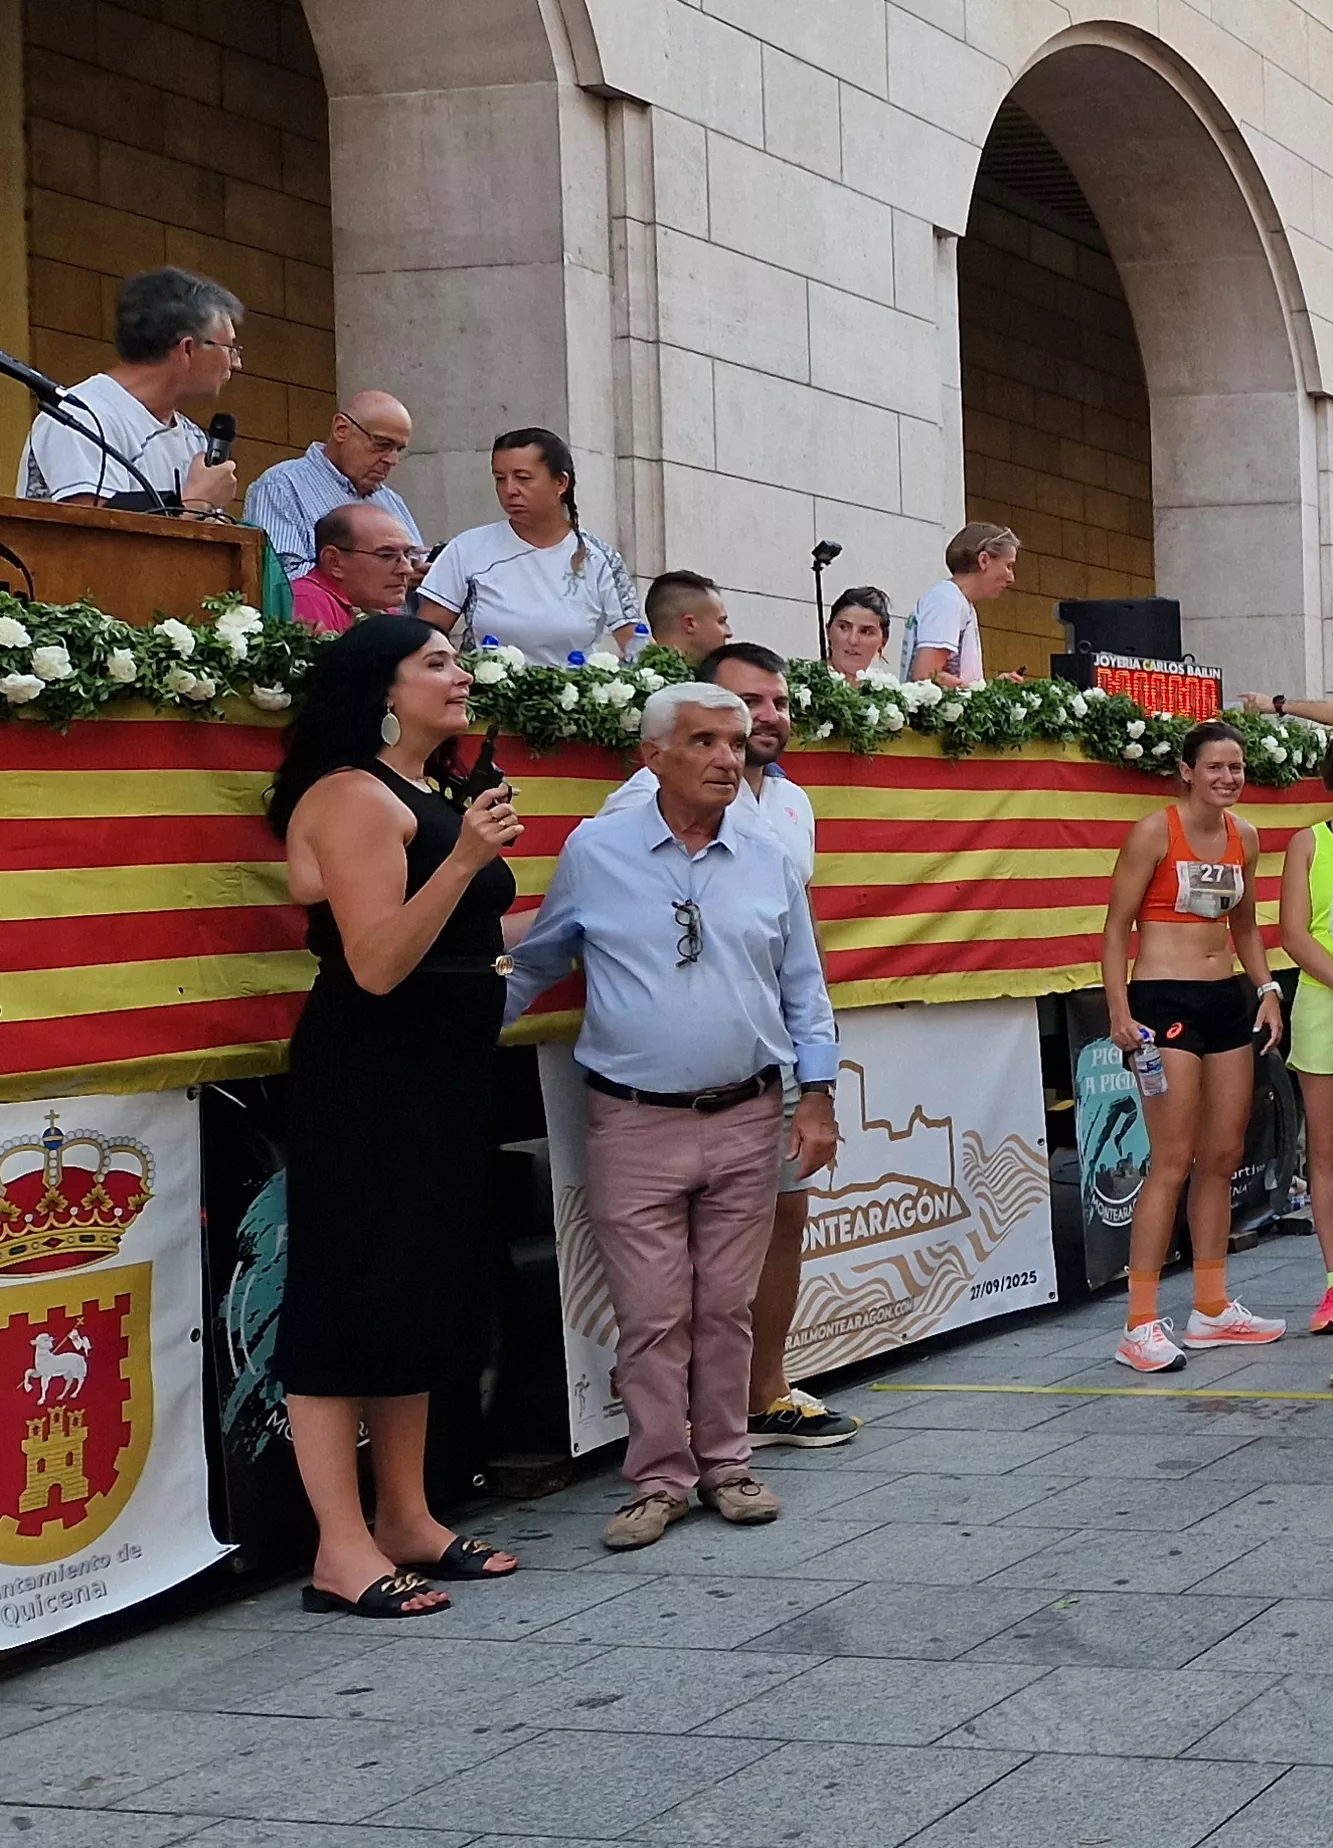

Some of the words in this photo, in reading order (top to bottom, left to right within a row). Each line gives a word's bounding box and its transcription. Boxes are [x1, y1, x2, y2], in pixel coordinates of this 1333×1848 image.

[1094, 653, 1141, 671] JOYERIA
[1143, 659, 1185, 676] CARLOS
[1200, 863, 1225, 883] 27
[969, 1270, 1038, 1302] 27/09/2025
[116, 1543, 143, 1563] de
[2, 1579, 108, 1629] Quicena
